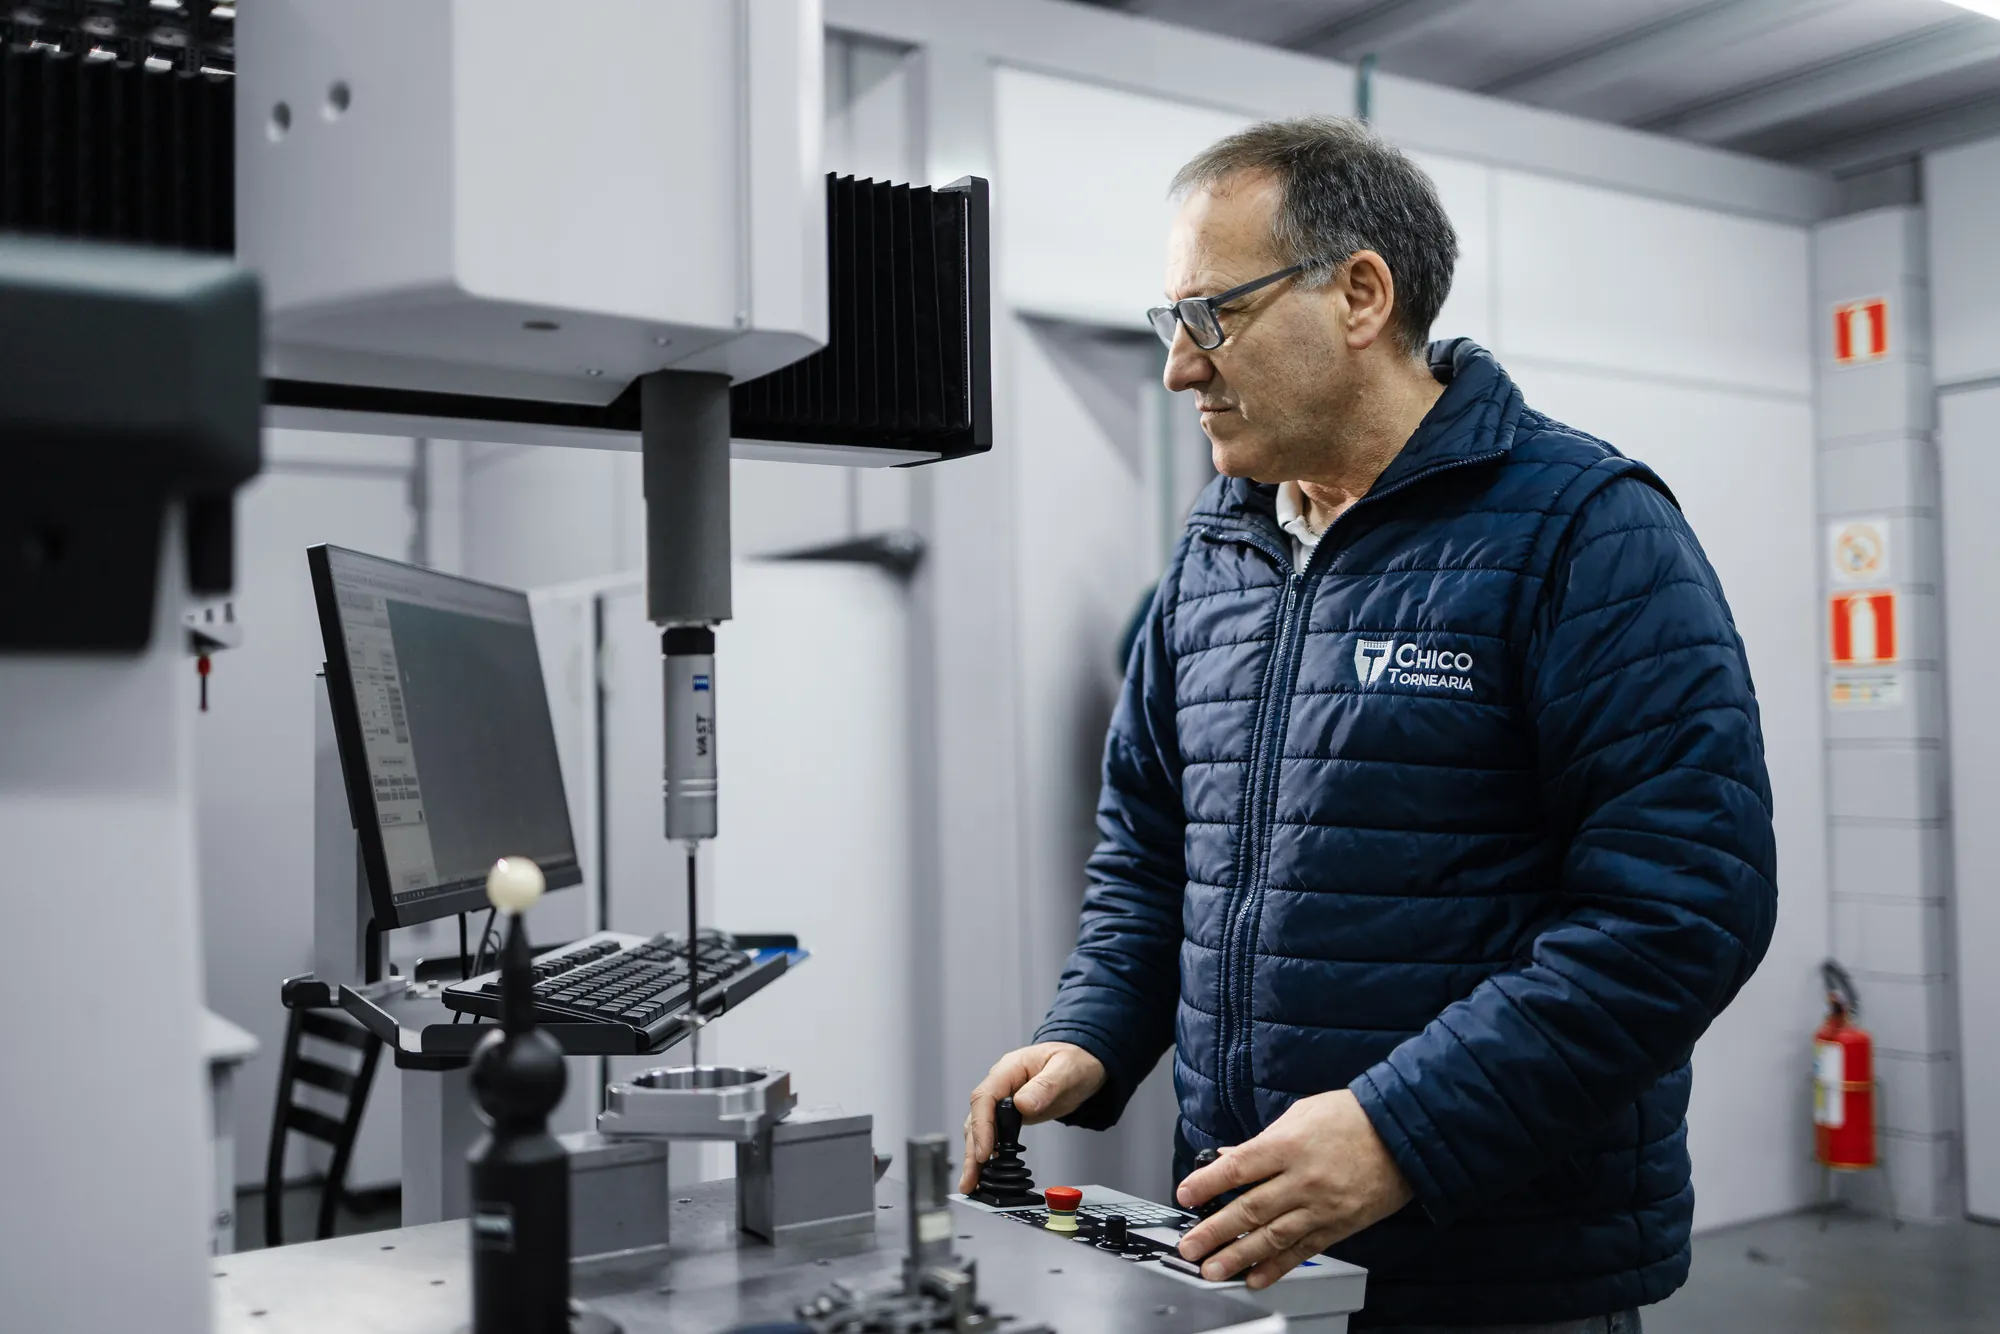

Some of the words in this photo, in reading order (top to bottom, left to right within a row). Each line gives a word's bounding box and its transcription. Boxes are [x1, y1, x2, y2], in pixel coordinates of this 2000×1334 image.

[1395, 642, 1473, 672] CHICO
[1388, 668, 1474, 692] TORNEARIA
[696, 713, 707, 757] VAST
